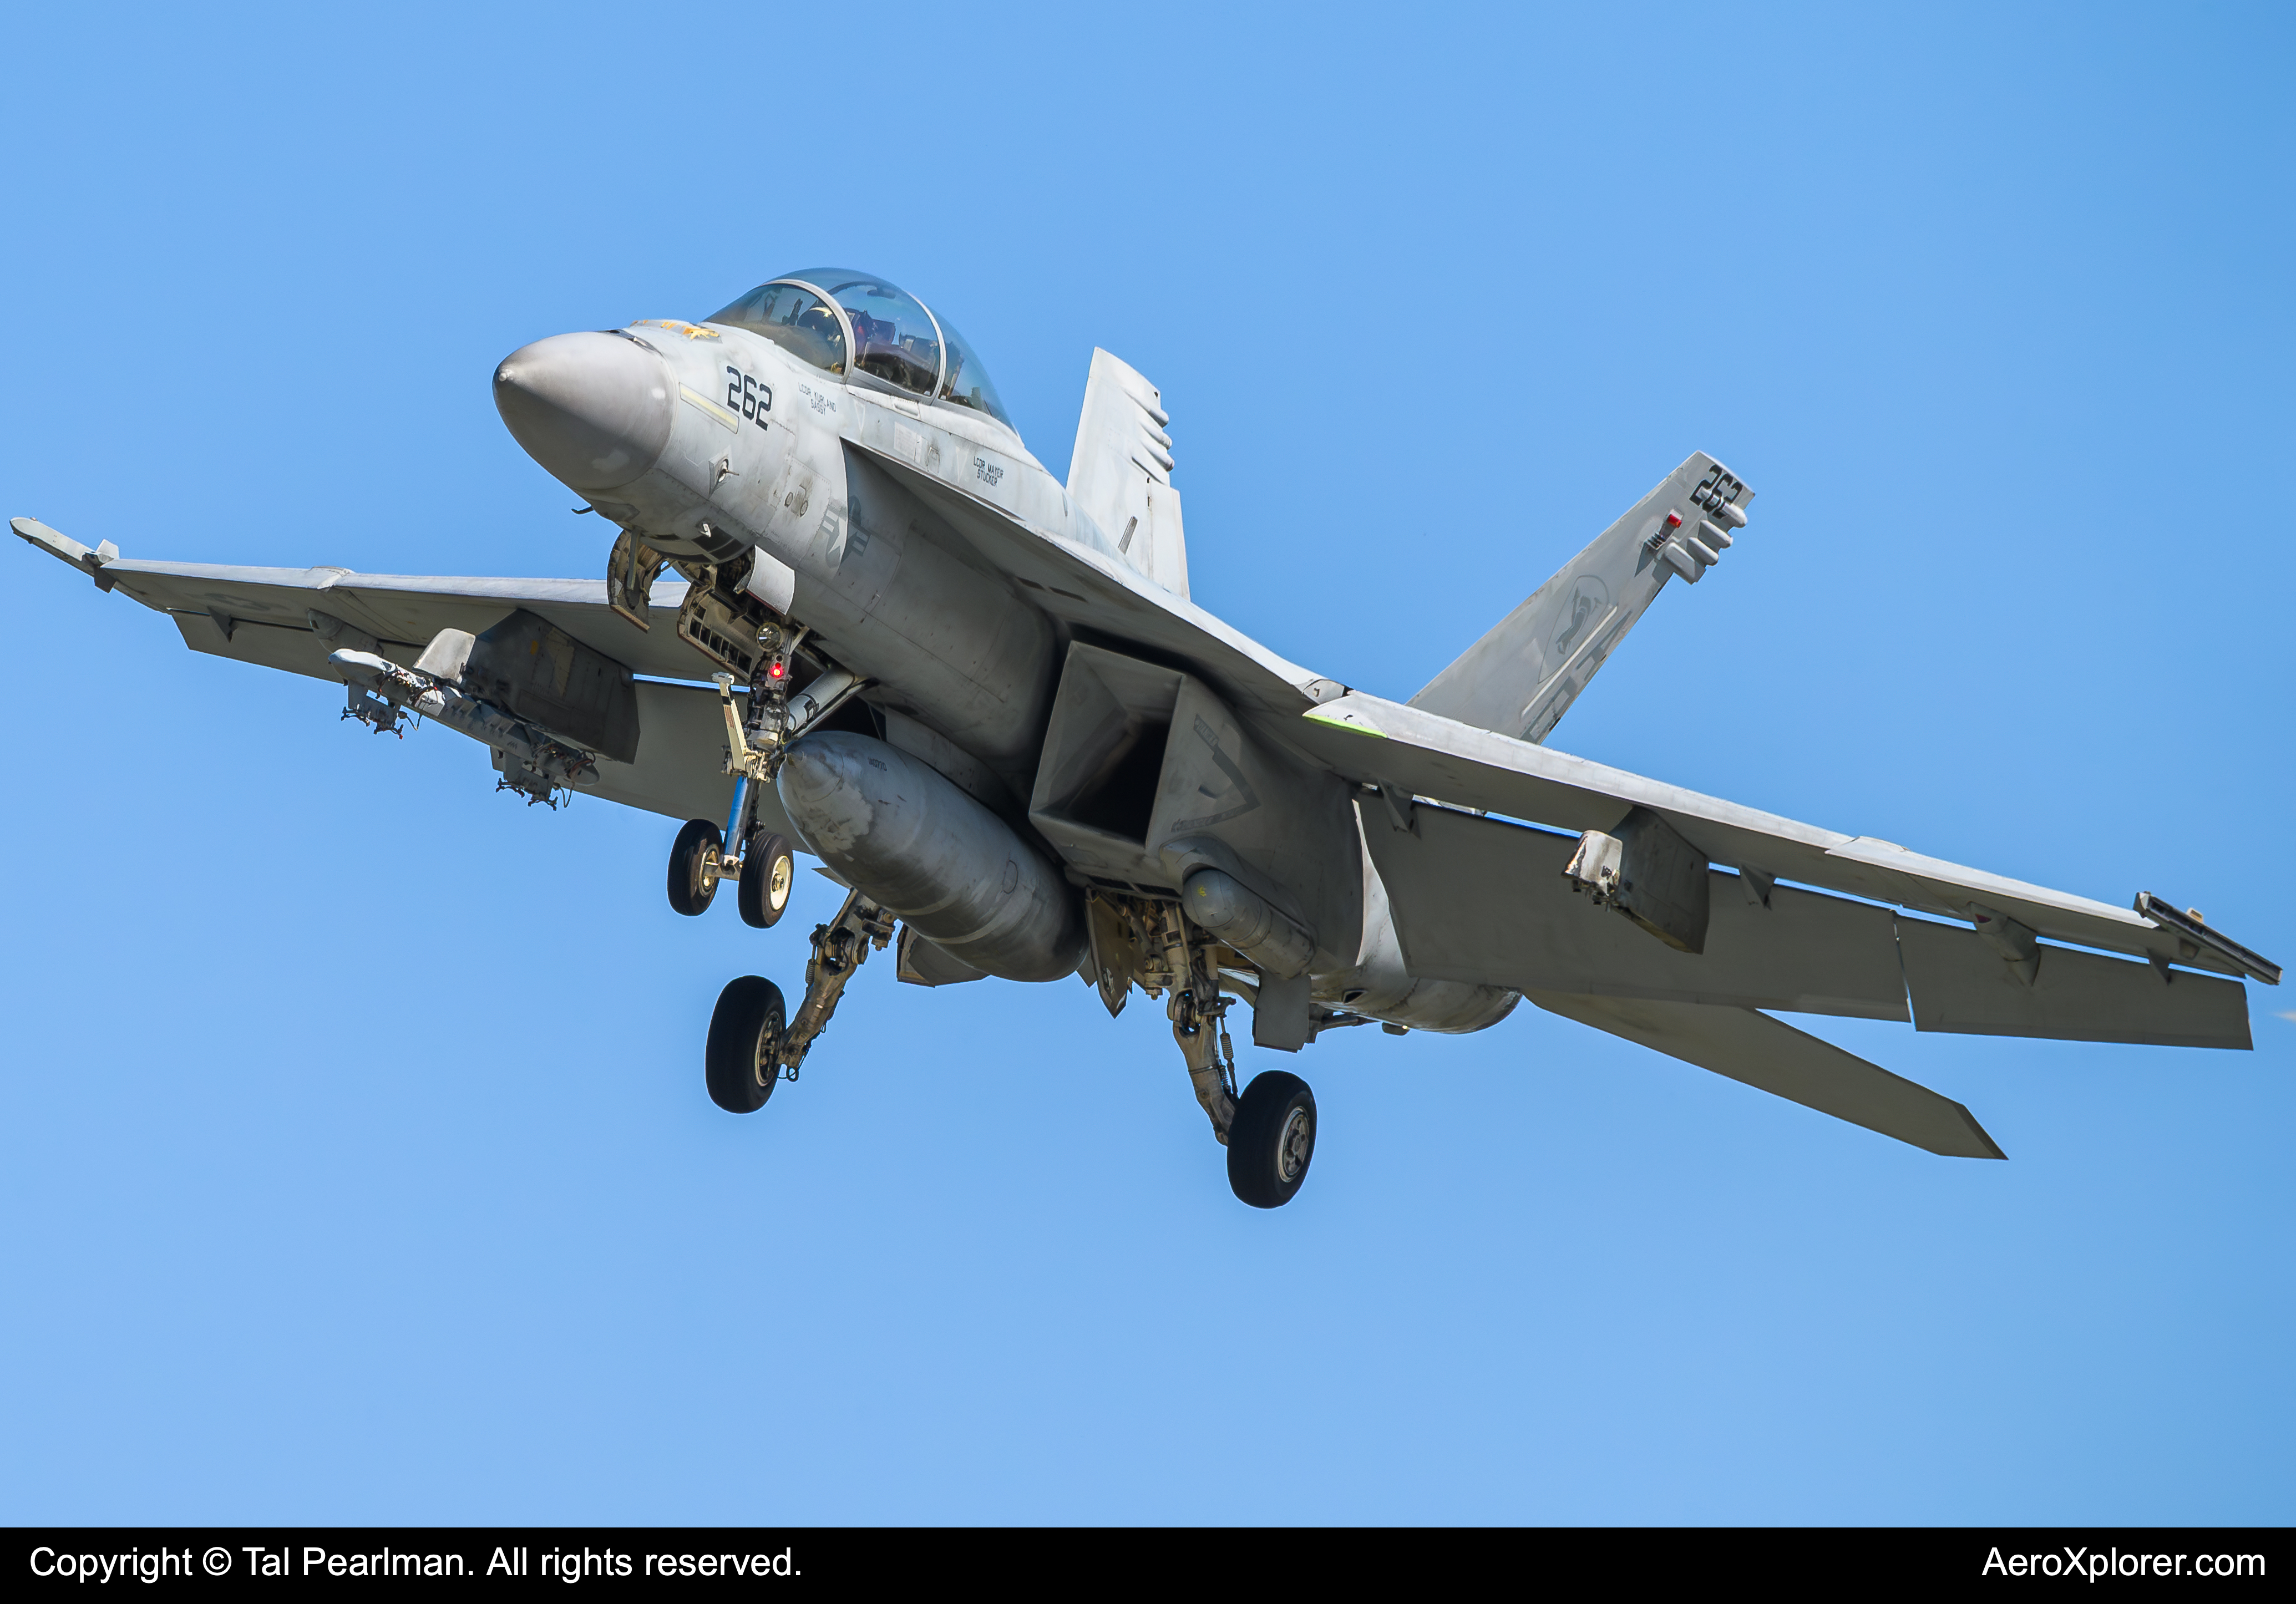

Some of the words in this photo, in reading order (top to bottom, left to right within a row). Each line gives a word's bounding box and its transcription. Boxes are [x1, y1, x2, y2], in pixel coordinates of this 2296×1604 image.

[726, 366, 772, 431] 262
[810, 398, 825, 416] SASSY
[973, 455, 986, 470] LCDR
[987, 463, 1003, 480] MAYER
[976, 468, 998, 488] STUCKER
[1689, 464, 1743, 520] 262
